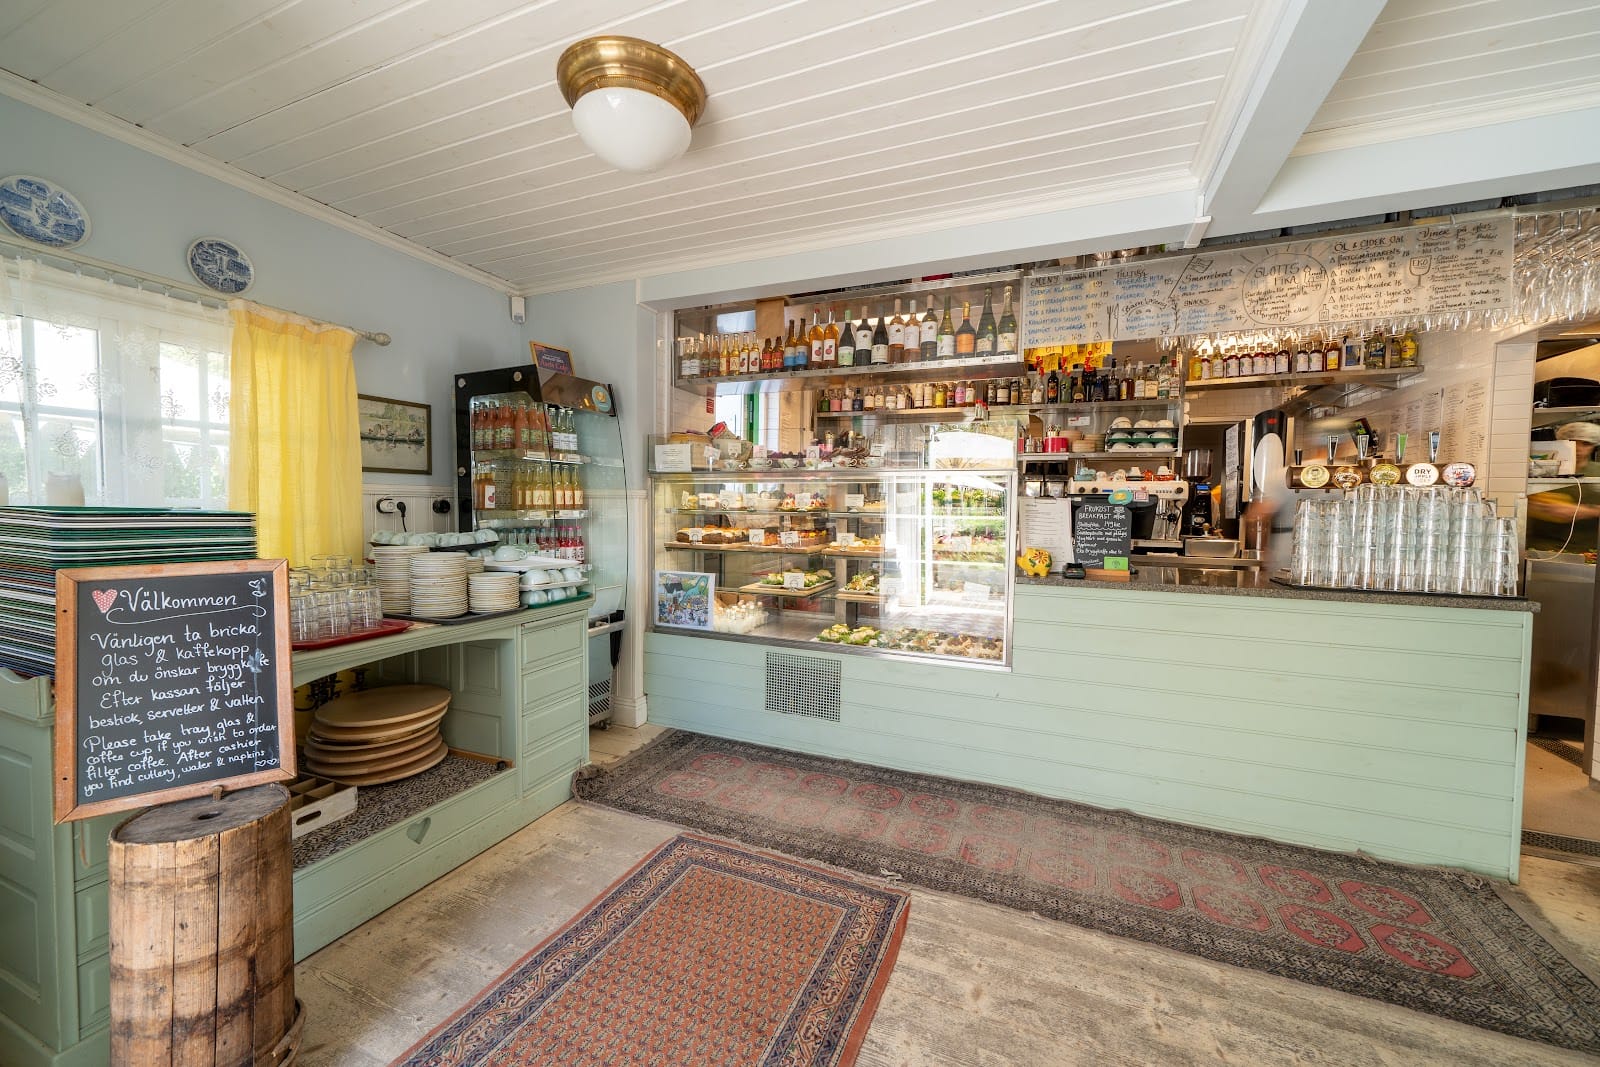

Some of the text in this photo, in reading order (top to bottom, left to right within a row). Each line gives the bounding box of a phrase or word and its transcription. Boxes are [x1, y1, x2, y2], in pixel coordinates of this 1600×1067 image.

[1334, 241, 1349, 252] ÖL
[1078, 512, 1112, 520] BREAKFAST
[120, 587, 236, 612] Välkommen
[91, 633, 175, 656] Vänligen
[184, 625, 201, 641] ta
[93, 653, 269, 686] om du önskar bryggkfe
[102, 644, 249, 677] glas & kaffekopp
[100, 676, 246, 709] Efter kassan följer
[147, 703, 205, 721] servetter
[210, 698, 220, 710] &
[226, 695, 264, 708] vatten
[83, 736, 136, 752] Please
[144, 730, 171, 743] take
[217, 720, 240, 733] glas
[246, 713, 254, 723] &
[87, 724, 277, 764] coffee cup if you wish to order
[84, 782, 103, 796] you
[110, 776, 133, 788] find
[181, 759, 212, 775] water
[217, 757, 225, 767] &
[229, 750, 265, 765] napkins
[86, 765, 121, 780] filter
[177, 750, 212, 764] After
[219, 739, 261, 753] cashier
